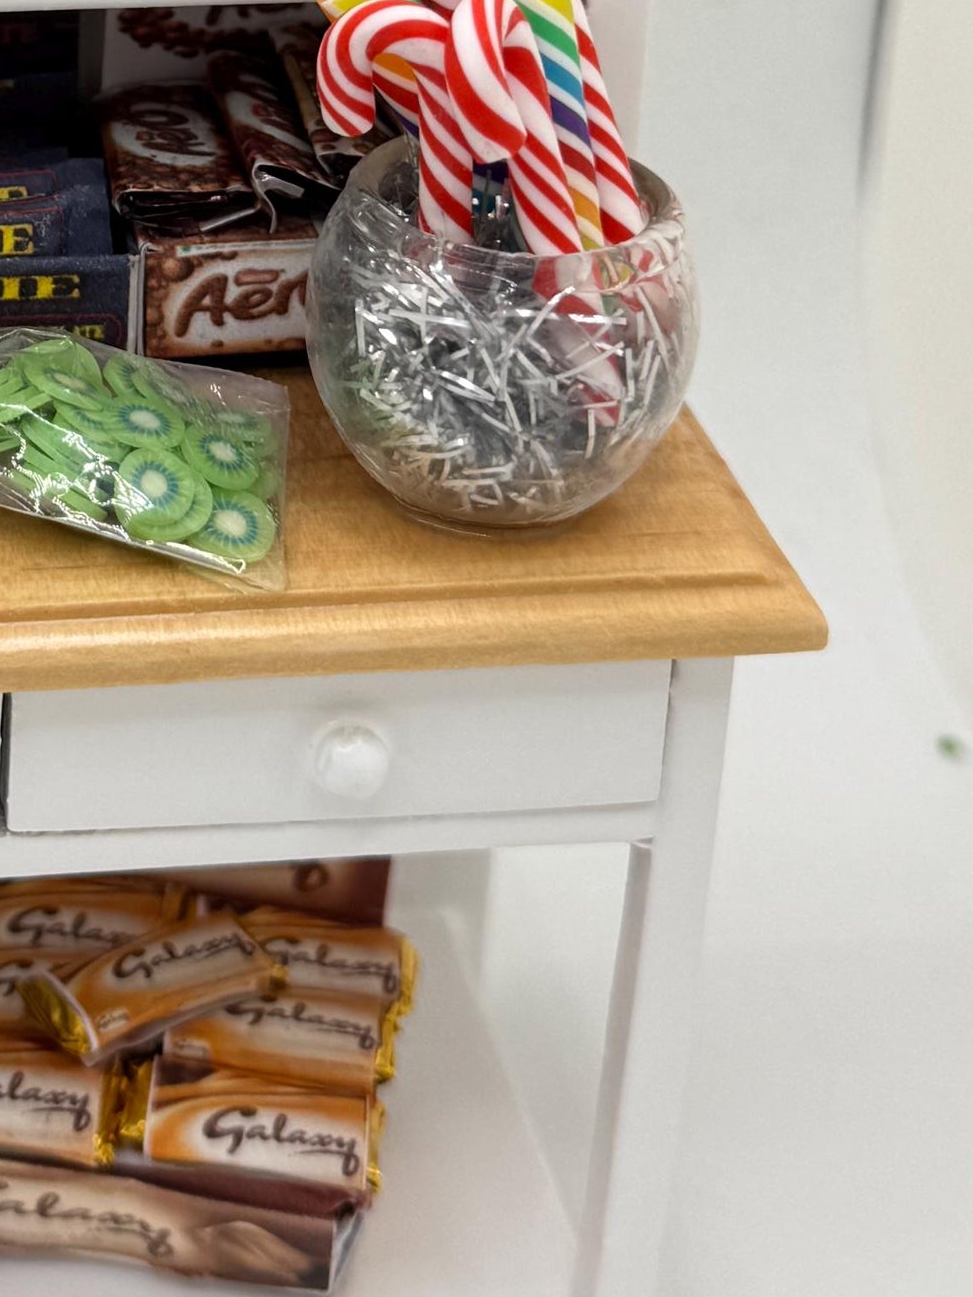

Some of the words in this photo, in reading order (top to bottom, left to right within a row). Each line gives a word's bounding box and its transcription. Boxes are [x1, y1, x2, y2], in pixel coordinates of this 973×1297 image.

[174, 267, 309, 338] Aer
[113, 932, 260, 980] Galaxy
[202, 1105, 361, 1177] Galaxy
